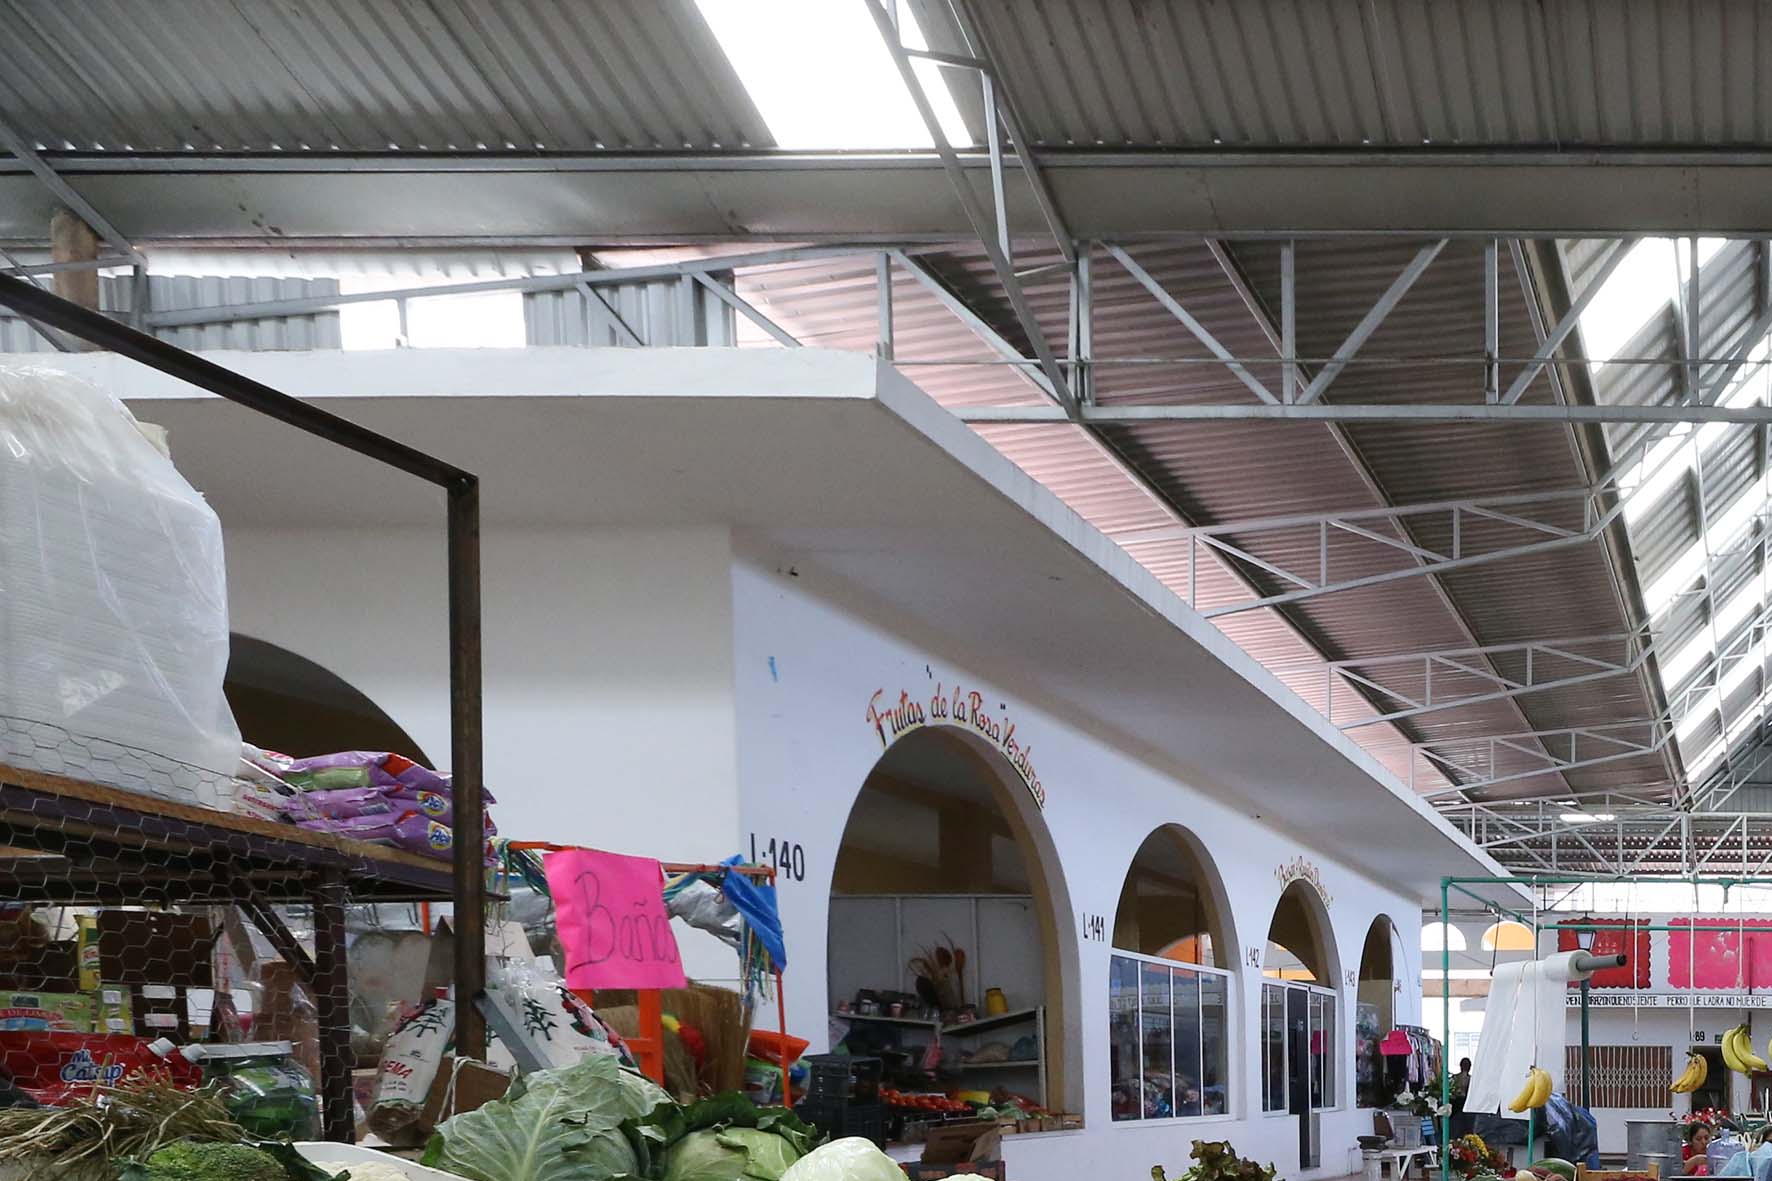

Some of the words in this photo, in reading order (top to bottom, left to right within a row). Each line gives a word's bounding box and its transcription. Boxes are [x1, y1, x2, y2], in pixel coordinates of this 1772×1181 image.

[866, 688, 927, 749] Frutas
[931, 682, 948, 719] de
[952, 686, 967, 722] la
[1001, 717, 1047, 808] Verduras
[569, 871, 678, 974] Baños
[1667, 997, 1688, 1006] PERRO
[1690, 997, 1702, 1006] UE
[1703, 997, 1725, 1006] LADRA
[1726, 997, 1735, 1006] NO
[1736, 997, 1767, 1007] MUERDE
